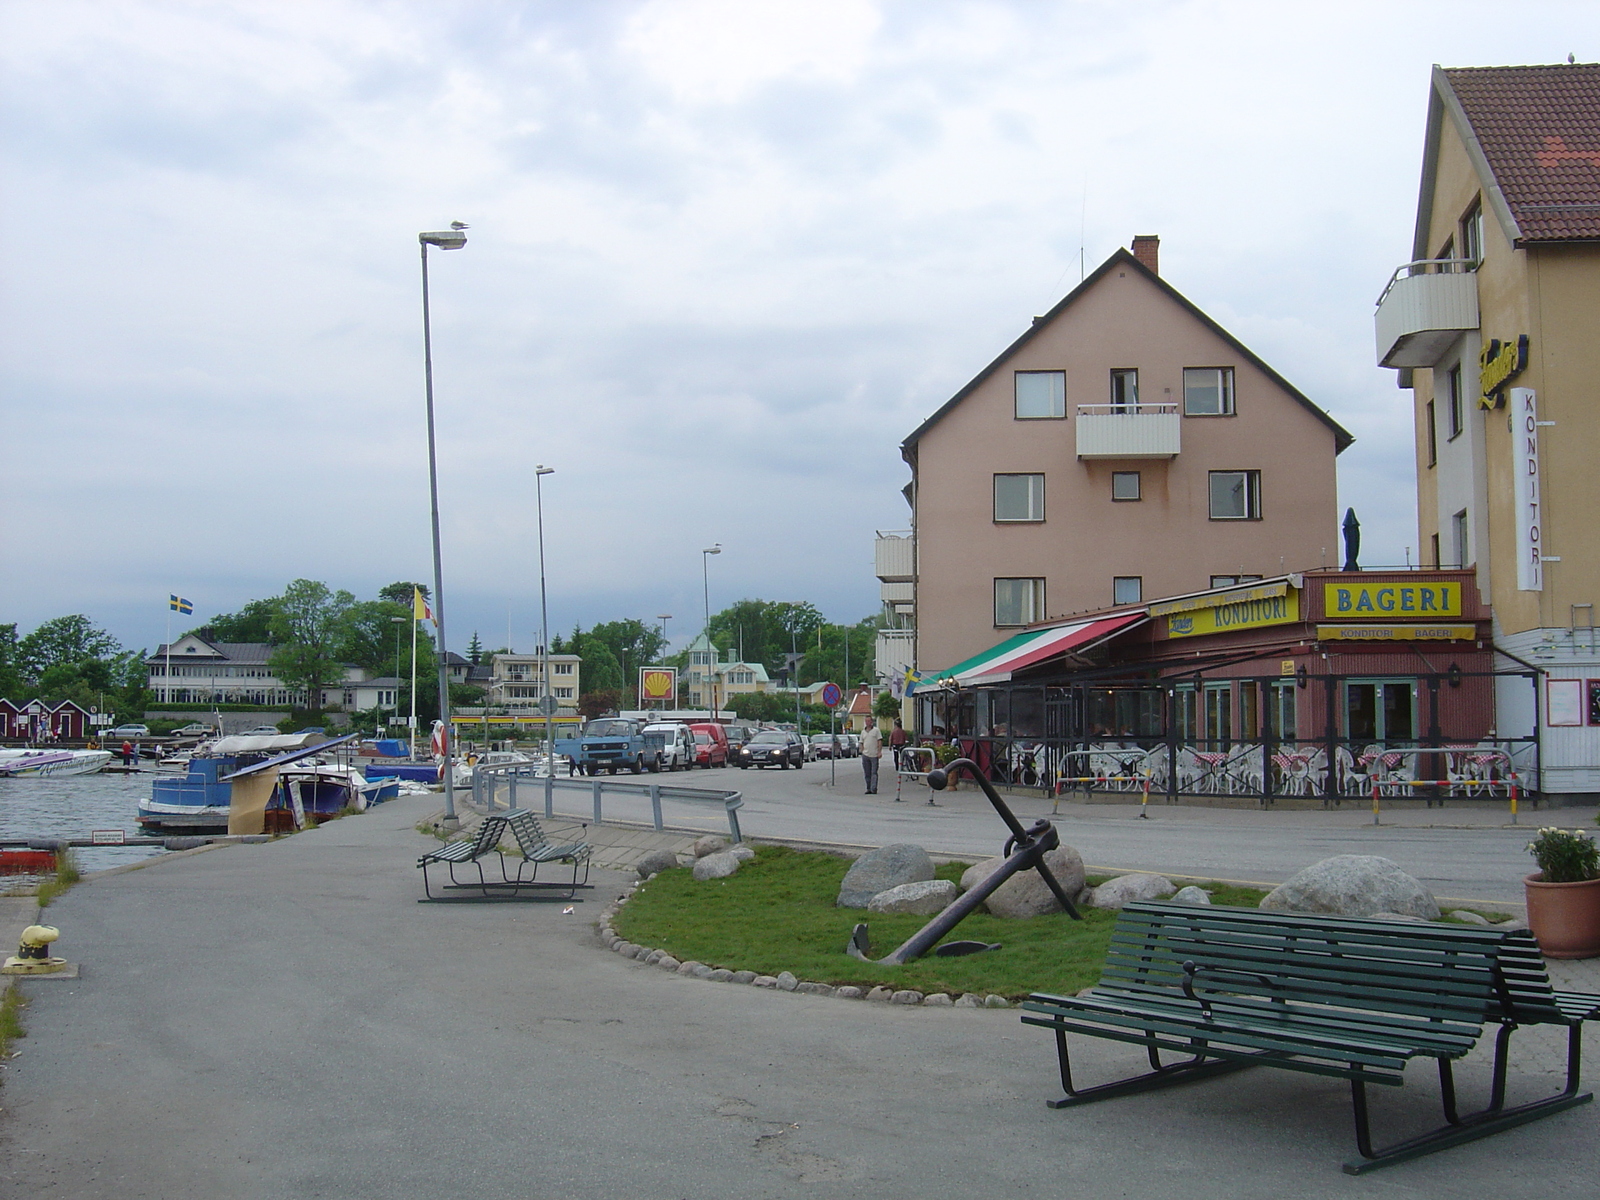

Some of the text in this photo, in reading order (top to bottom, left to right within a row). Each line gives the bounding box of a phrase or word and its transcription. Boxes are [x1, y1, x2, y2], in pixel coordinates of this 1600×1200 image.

[1524, 394, 1541, 585] KONDITORI
[1214, 596, 1287, 627] KONDITORI
[1337, 587, 1450, 612] BAGERI
[1340, 629, 1453, 638] KONDITORI BAGERI
